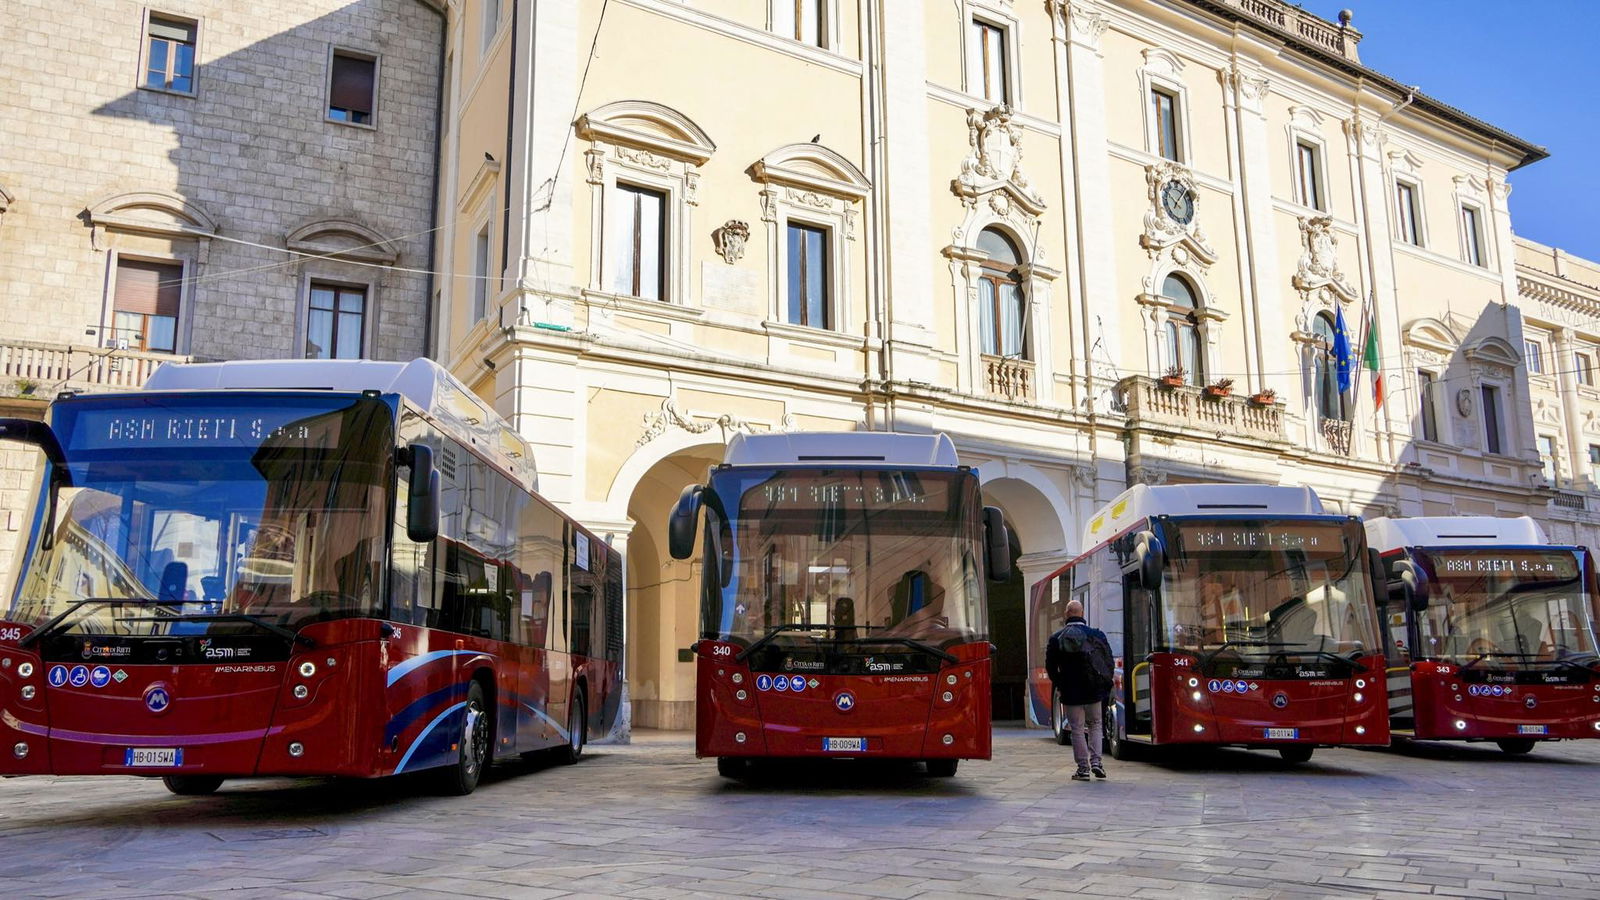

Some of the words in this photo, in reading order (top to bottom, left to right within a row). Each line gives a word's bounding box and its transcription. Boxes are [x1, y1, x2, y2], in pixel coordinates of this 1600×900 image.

[167, 418, 236, 439] RIETI
[1477, 559, 1514, 571] RIETI
[0, 628, 21, 640] 345
[205, 648, 234, 658] asm
[713, 645, 731, 656] 340
[869, 663, 891, 671] asm
[1174, 658, 1188, 666] 341
